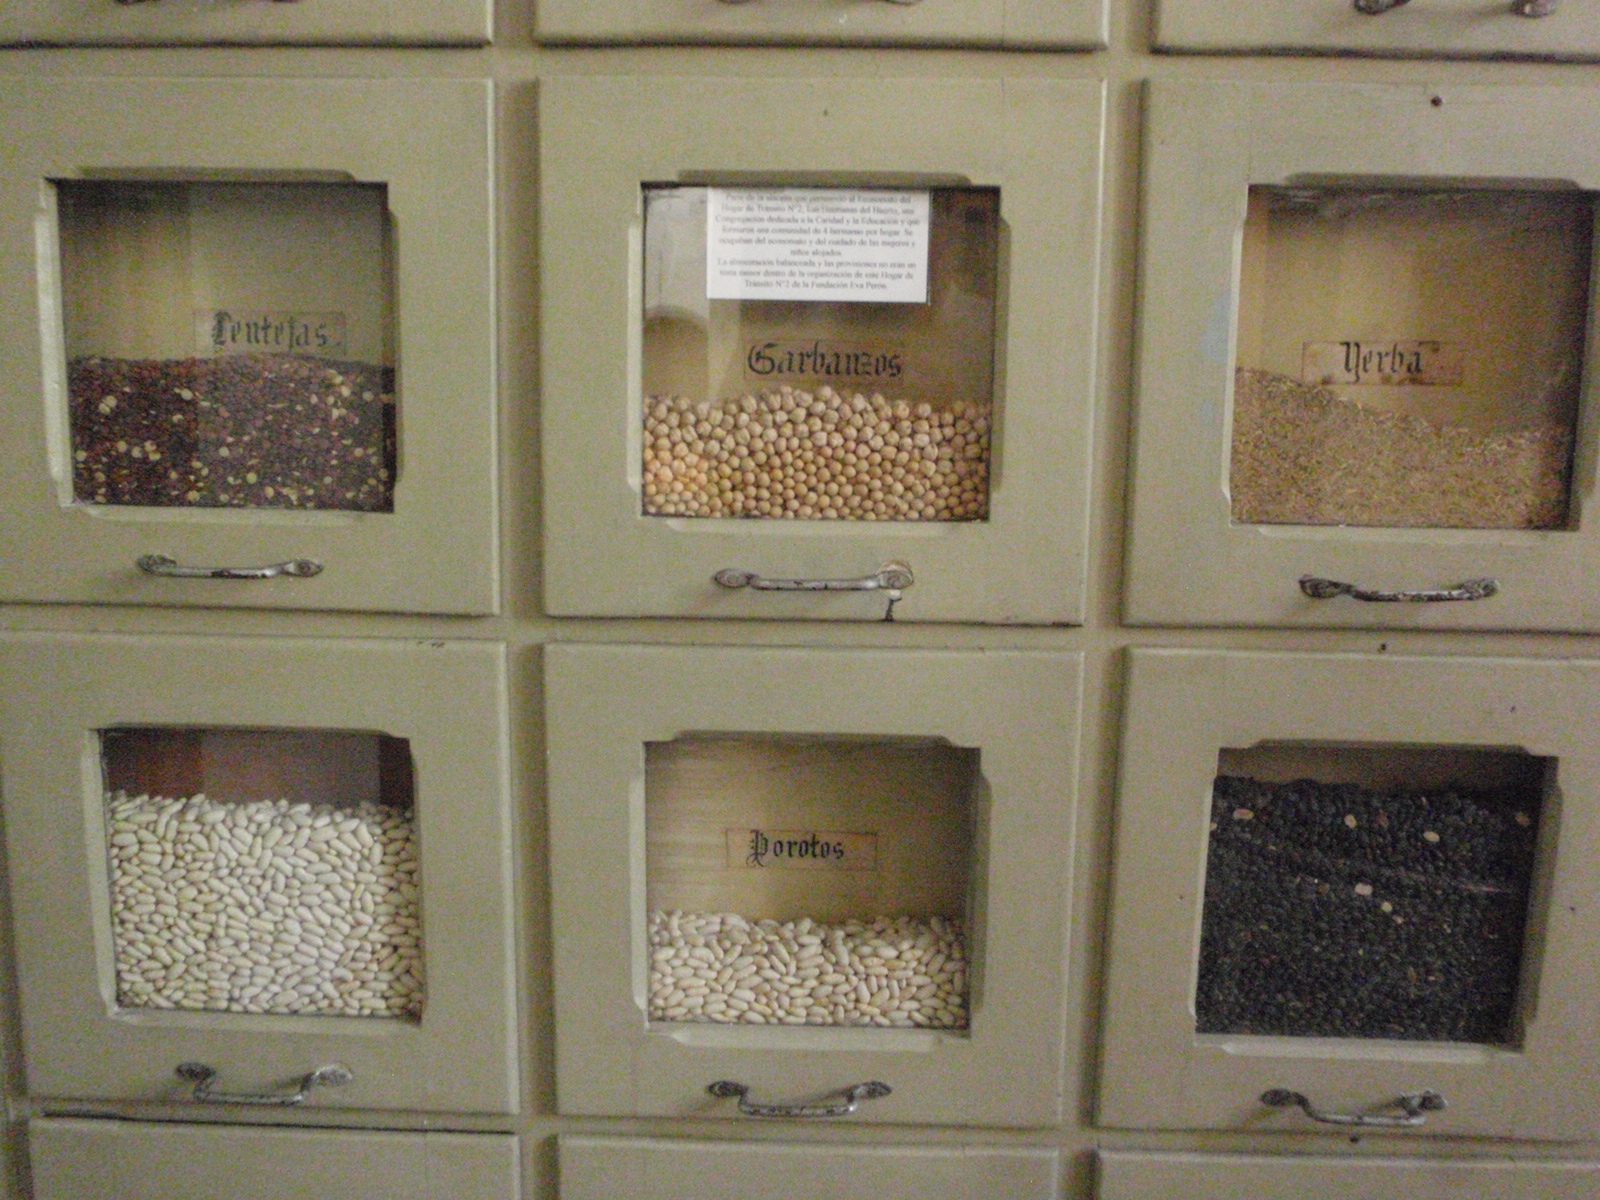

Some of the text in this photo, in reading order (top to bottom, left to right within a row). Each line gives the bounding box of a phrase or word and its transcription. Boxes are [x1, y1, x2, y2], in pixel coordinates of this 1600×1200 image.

[748, 340, 902, 377] Garbanzos
[1340, 341, 1423, 383] Yerba
[746, 829, 844, 867] Porotos
